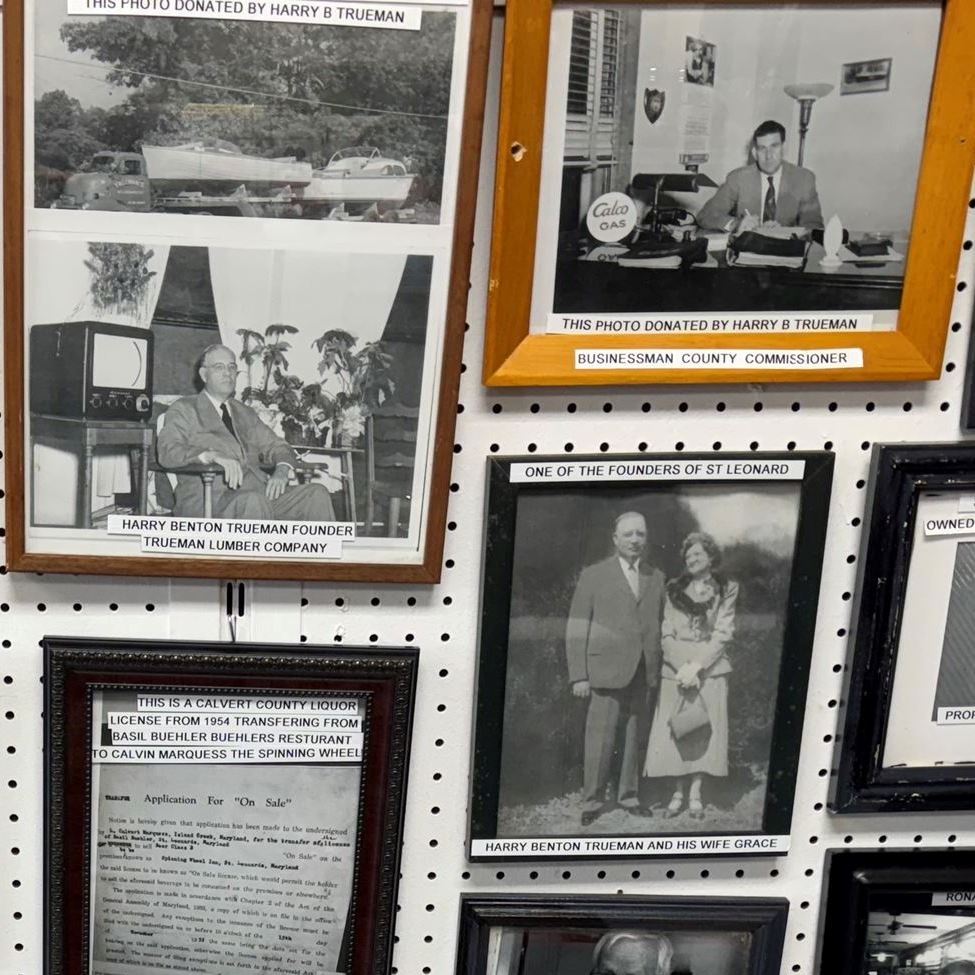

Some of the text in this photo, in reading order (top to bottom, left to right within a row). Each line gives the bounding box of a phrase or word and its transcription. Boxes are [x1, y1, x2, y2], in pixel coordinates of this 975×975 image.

[600, 220, 626, 230] GAS
[578, 352, 847, 365] BUSINESSMAN COUNTY COMMISSIONER
[525, 463, 789, 477] ONE OF THE FOUNDERS OF ST LEONARD
[122, 519, 353, 536] HARRY BENTON TRUEMAN FOUNDER
[927, 518, 975, 530] OWNED
[144, 536, 327, 553] TRUEMAN LUMBER COMPANY
[139, 698, 356, 711] THIS IS A CALVERT COUNTY LIQUOR
[93, 748, 361, 760] TO CALVIN MARQUESS THE SPINNING WHEEL
[143, 794, 197, 806] Application
[207, 795, 224, 805] For
[485, 838, 778, 852] HARRY BENTON TRUEMAN AND HIS WIFE GRACE
